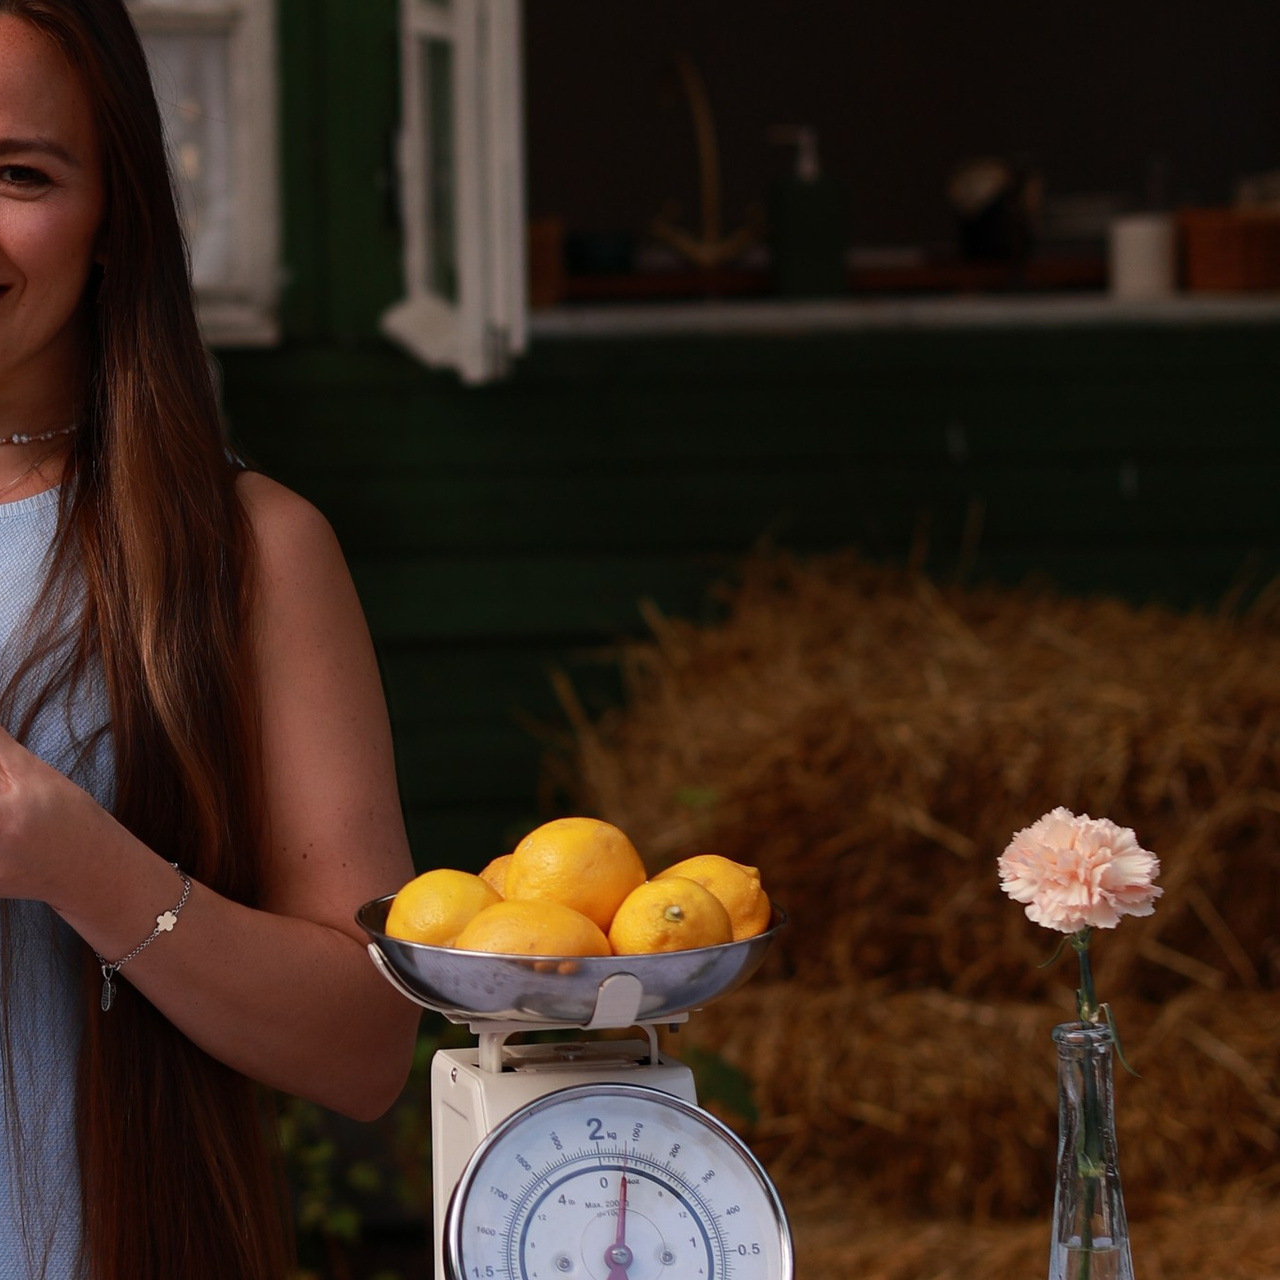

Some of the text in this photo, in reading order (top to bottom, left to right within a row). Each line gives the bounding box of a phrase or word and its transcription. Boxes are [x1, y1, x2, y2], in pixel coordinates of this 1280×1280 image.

[586, 1118, 617, 1141] 2 kg
[632, 1122, 644, 1142] 100g
[549, 1131, 563, 1151] 1900
[669, 1143, 681, 1158] 200
[514, 1153, 532, 1171] 1800
[599, 1177, 608, 1188] 0
[701, 1169, 716, 1183] 300
[490, 1186, 509, 1200] 1700
[558, 1194, 566, 1205] 4
[726, 1205, 741, 1216] 400
[476, 1226, 496, 1236] 1600
[689, 1237, 697, 1248] 1
[738, 1243, 760, 1256] 0.5
[472, 1265, 494, 1279] 1.5
